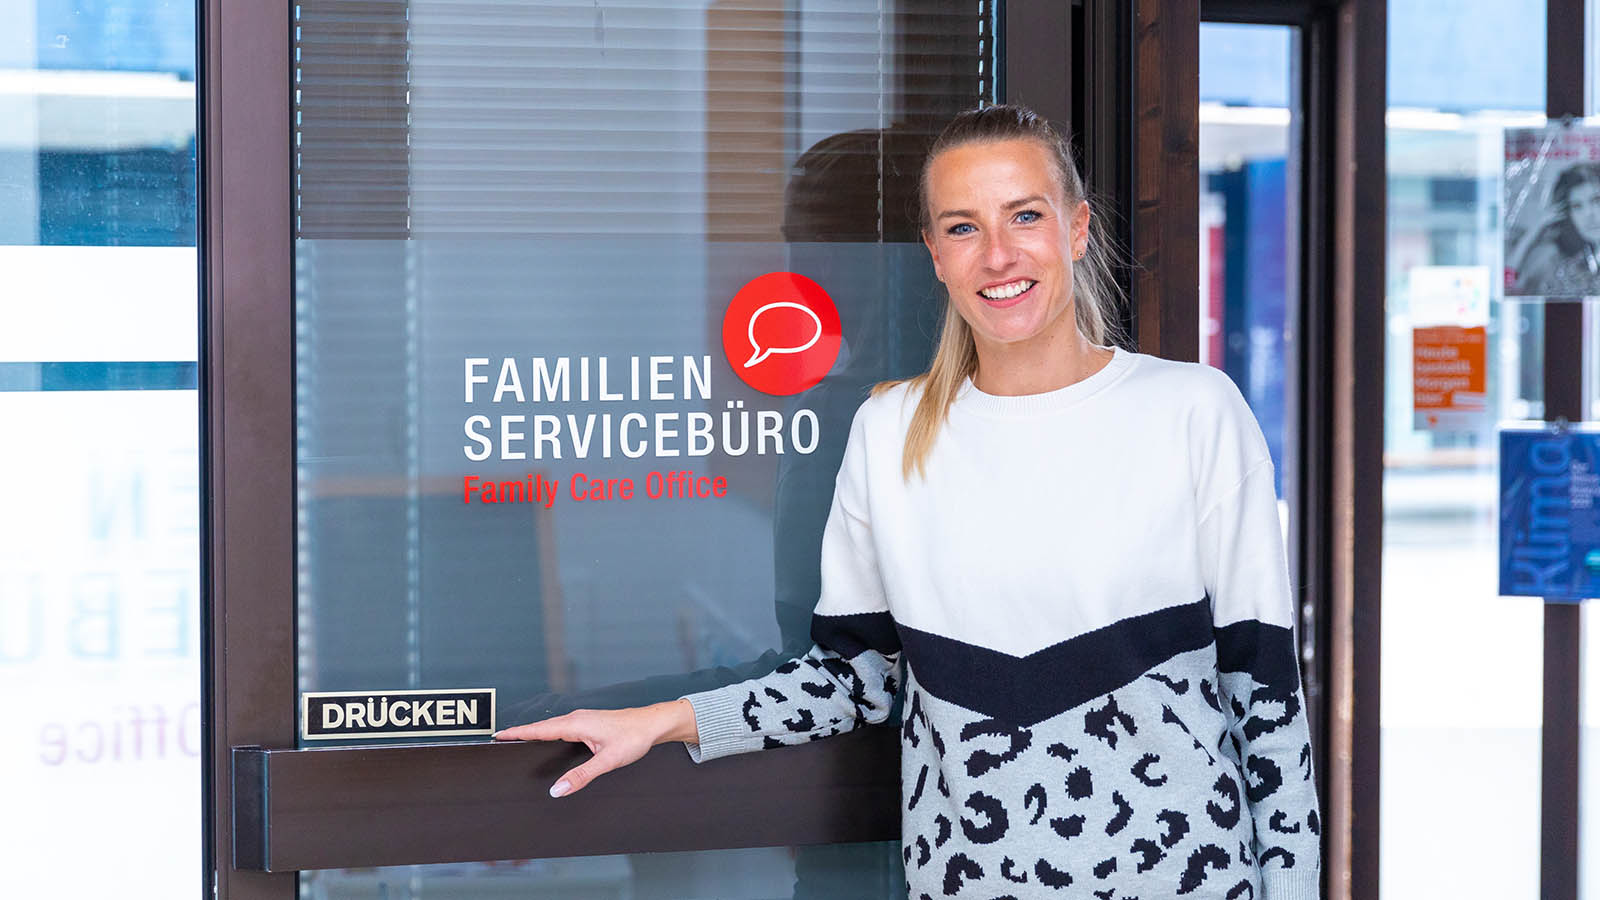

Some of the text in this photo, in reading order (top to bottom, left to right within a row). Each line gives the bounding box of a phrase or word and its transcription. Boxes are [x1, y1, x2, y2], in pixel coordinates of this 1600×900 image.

[464, 355, 712, 403] FAMILIEN
[463, 400, 820, 461] SERVICEBÜRO
[463, 470, 728, 508] Family Care Office
[322, 697, 478, 729] DRÜCKEN
